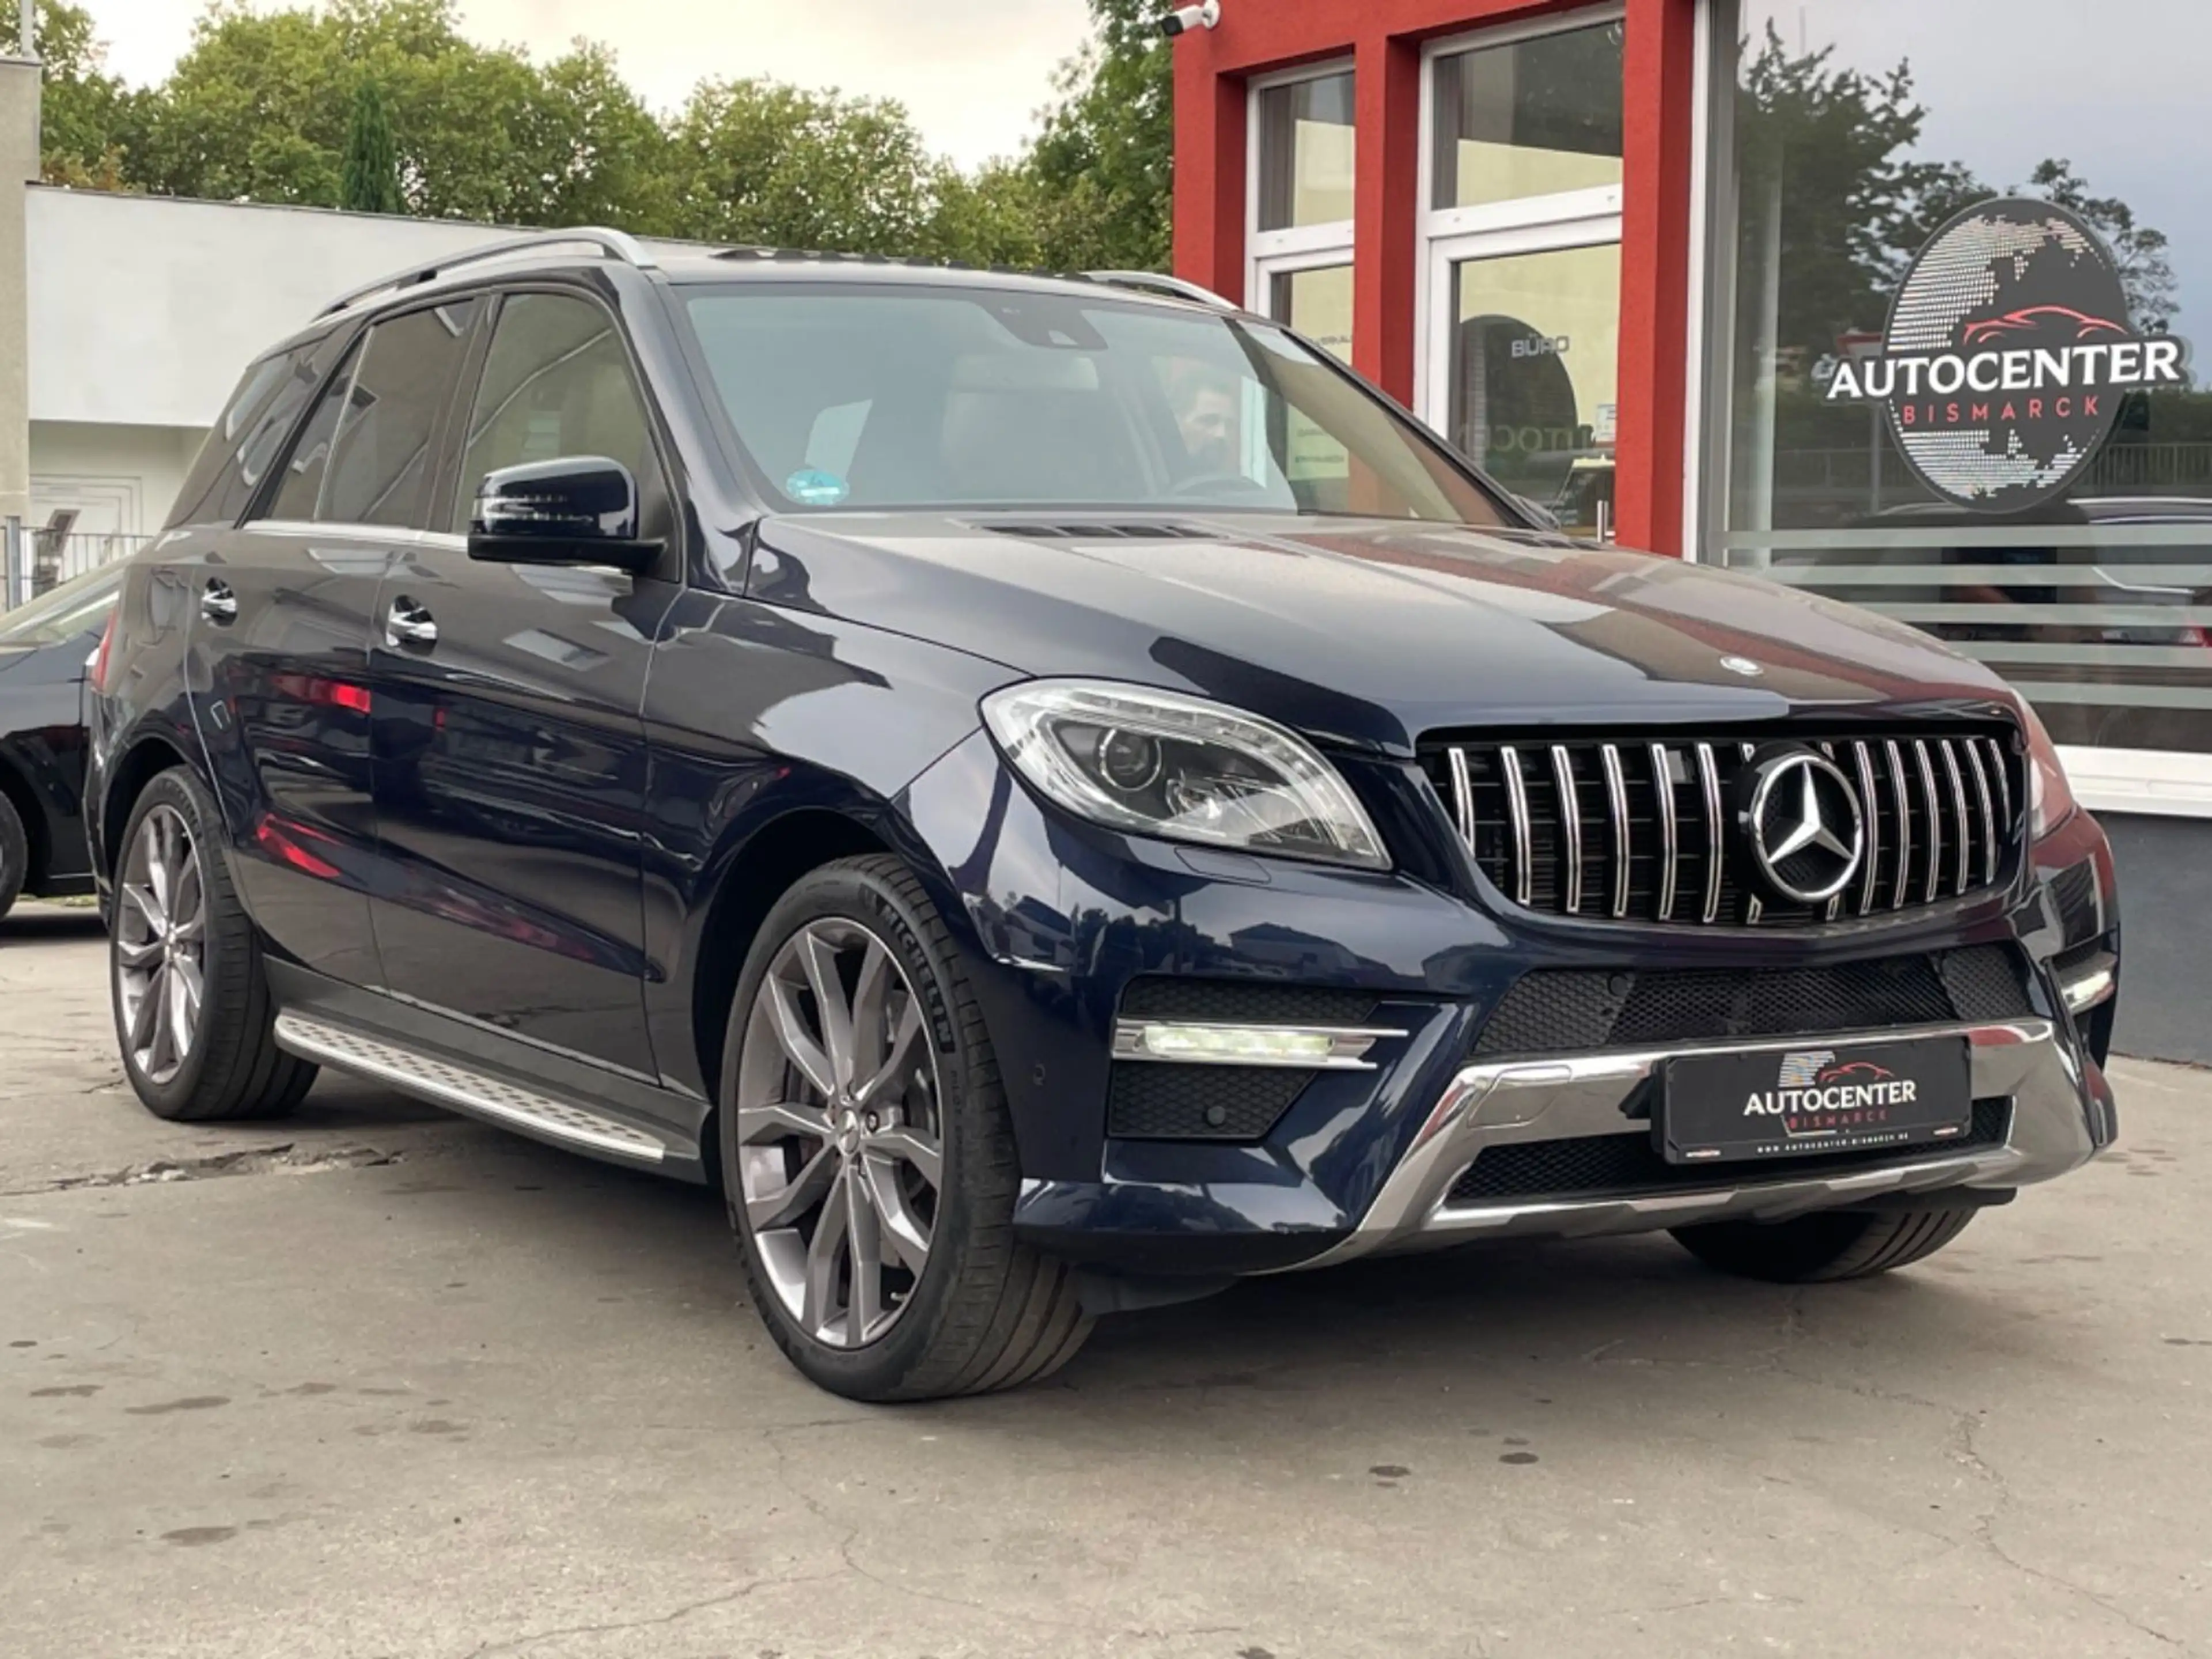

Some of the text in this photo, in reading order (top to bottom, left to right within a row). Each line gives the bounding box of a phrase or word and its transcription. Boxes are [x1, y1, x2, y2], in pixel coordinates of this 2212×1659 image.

[1511, 332, 1570, 358] BÜRO
[1827, 340, 2180, 400] AUTOCENTER
[1903, 395, 2100, 425] BISMARCK
[880, 901, 953, 1044] MICHELIN
[1743, 1079, 1917, 1116] AUTOCENTER
